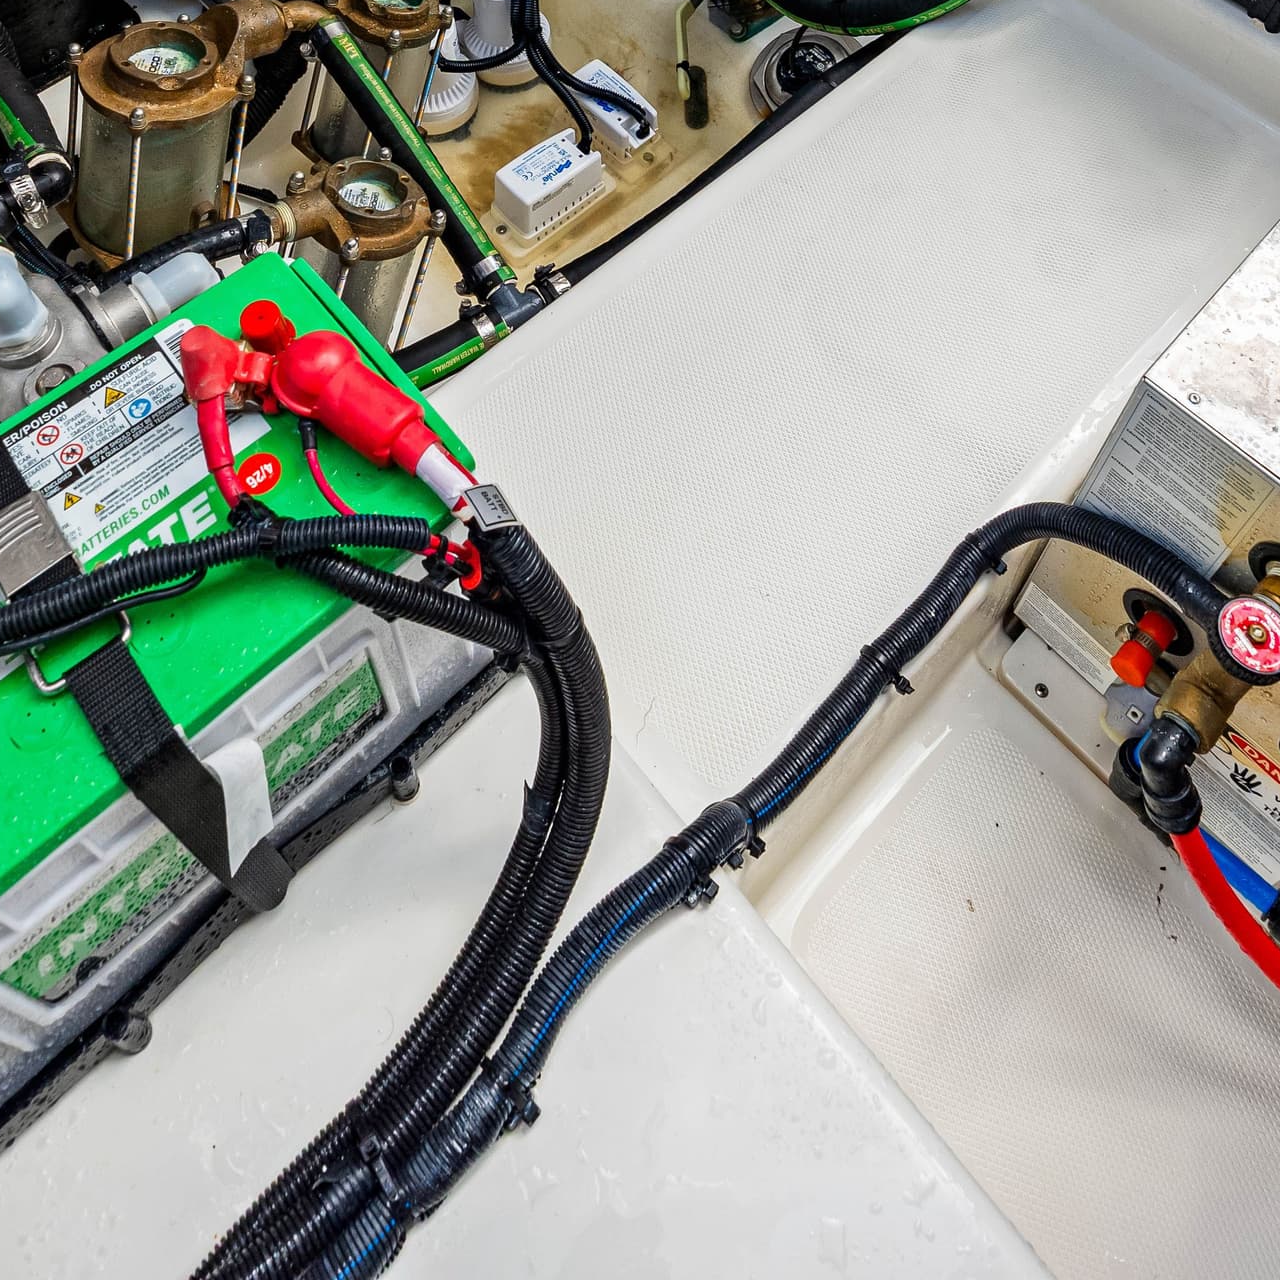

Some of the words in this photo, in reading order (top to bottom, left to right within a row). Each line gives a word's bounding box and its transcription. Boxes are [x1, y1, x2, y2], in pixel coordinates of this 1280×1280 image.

[339, 37, 361, 60] MPI
[541, 169, 559, 184] rule
[109, 364, 142, 387] SULFURIC
[141, 354, 157, 367] ACID
[118, 379, 132, 390] CAN
[130, 368, 149, 382] CAUSE
[124, 370, 157, 393] BLINDNESS
[0, 399, 70, 448] ER/POISON
[88, 378, 104, 391] DO
[101, 367, 120, 383] NOT
[118, 351, 145, 371] OPEN.
[112, 391, 137, 409] SEVERE
[147, 383, 165, 397] READ
[55, 413, 67, 423] NO
[62, 408, 88, 427] SPARKS
[65, 413, 92, 432] FLAMES
[68, 416, 99, 437] SMOKING
[88, 444, 111, 461] REPAIR
[108, 430, 133, 448] SHOULD
[130, 421, 146, 434] ONLY
[150, 396, 184, 420] PERFORMED
[79, 428, 97, 442] KEEP
[95, 420, 110, 431] OUT
[81, 435, 95, 446] THE
[93, 421, 117, 439] REACH
[93, 423, 126, 446] CHILDREN
[104, 436, 134, 458] QUALIFIED
[131, 421, 156, 439] SERVICE
[152, 401, 186, 425] TECHNICIAN
[42, 470, 74, 492] ENCLOSED
[245, 462, 273, 489] 4/26
